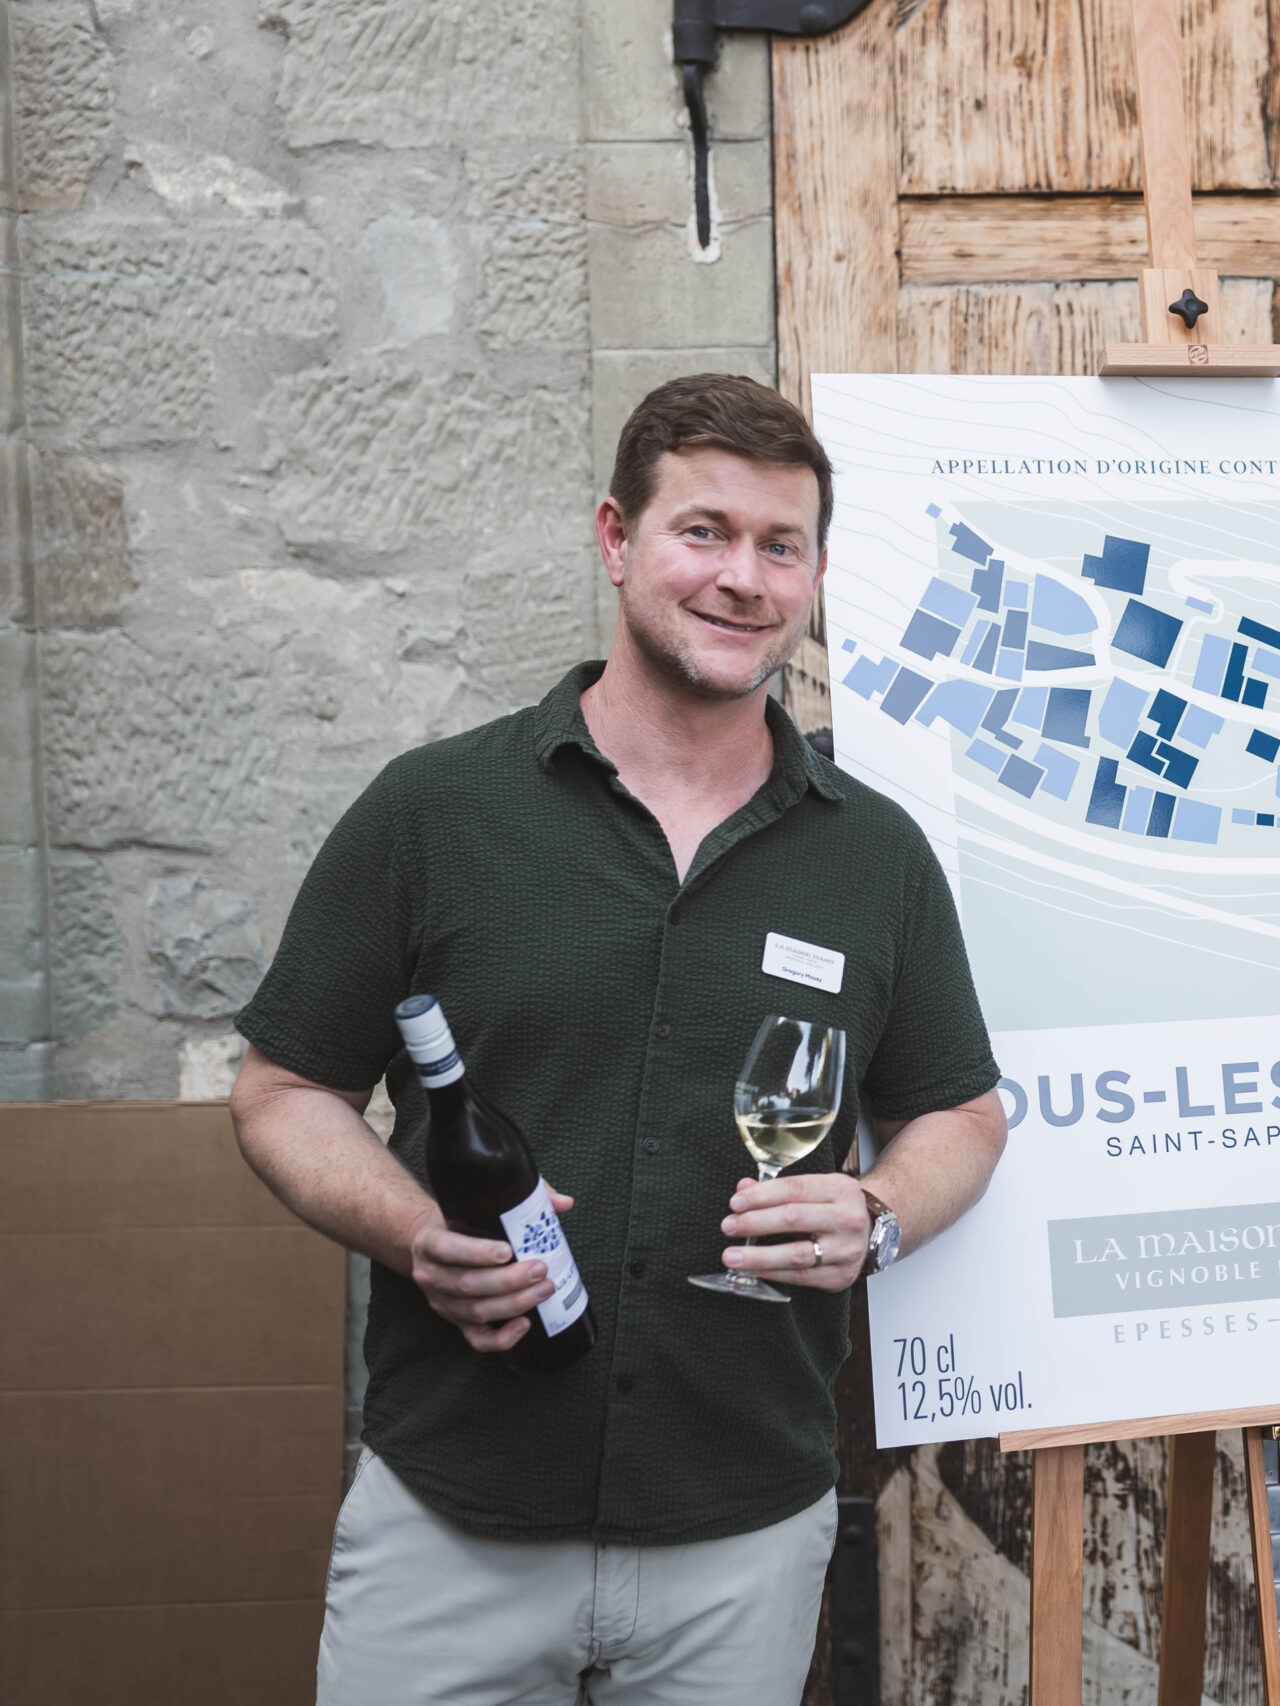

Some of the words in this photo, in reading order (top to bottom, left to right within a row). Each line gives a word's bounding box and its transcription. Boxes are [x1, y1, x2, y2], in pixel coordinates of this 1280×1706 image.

[930, 459, 1087, 475] APPELLATION
[1096, 459, 1212, 475] D'ORIGINE
[1073, 1237, 1128, 1264] LA
[1115, 1260, 1261, 1291] VIGNOBLE
[893, 1336, 927, 1378] 70
[936, 1333, 956, 1374] cl
[898, 1375, 982, 1423] 12,5%
[989, 1371, 1032, 1412] vol.
